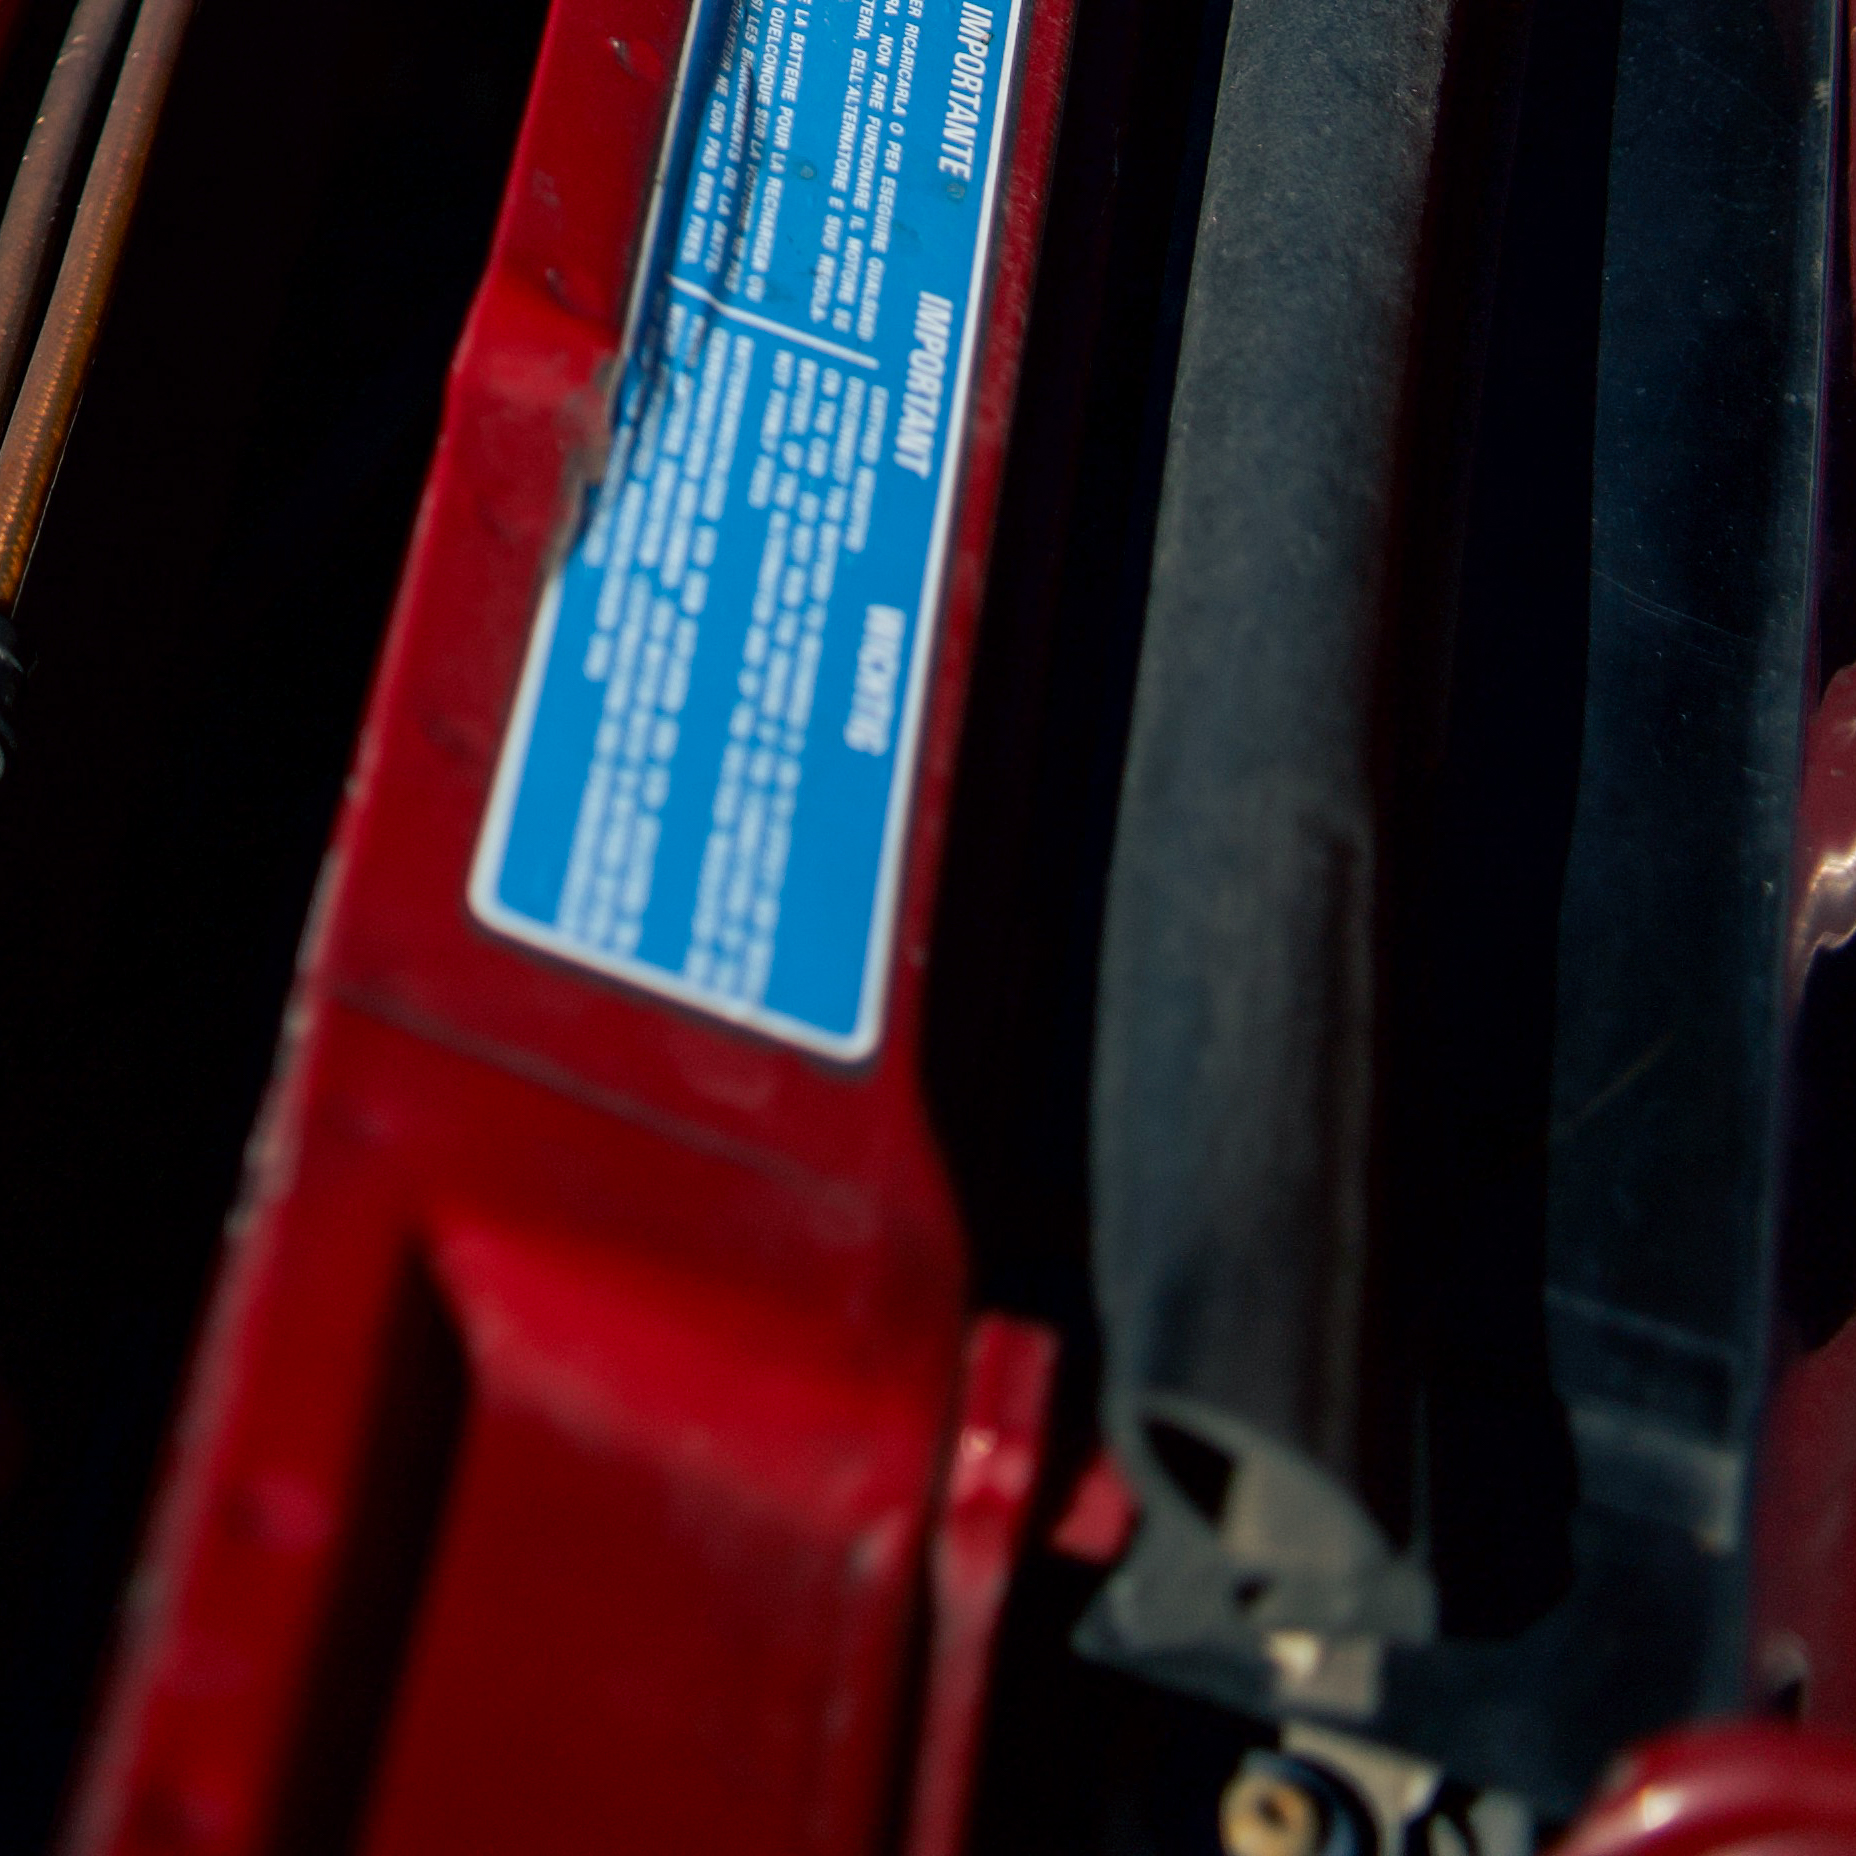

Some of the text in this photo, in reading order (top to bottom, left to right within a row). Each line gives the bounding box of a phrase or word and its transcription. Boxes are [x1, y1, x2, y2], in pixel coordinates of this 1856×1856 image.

[742, 13, 761, 45] LES
[793, 6, 809, 29] LA
[756, 5, 784, 107] QUELCONQUE
[780, 30, 805, 103] BATTERIE
[875, 32, 893, 68] NON
[891, 21, 920, 118] RICARICARLA
[714, 73, 730, 97] NE
[725, 45, 755, 164] BRANCHEMENTS
[868, 70, 887, 111] FARE
[937, 0, 993, 182] IMPORTANTE
[707, 98, 726, 134] SON
[751, 105, 769, 139] SUR
[771, 103, 793, 151] POUR
[829, 46, 865, 192] DELL'ALTERNATORE
[699, 135, 721, 170] PAS
[747, 138, 764, 161] LA
[767, 149, 785, 175] LA
[851, 113, 881, 211] FUNZIONARE
[882, 138, 901, 173] PER
[720, 164, 738, 191] DE
[715, 191, 733, 216] LA
[847, 212, 866, 234] IL
[869, 173, 896, 254] ESEGUIRE
[819, 211, 840, 252] SUO
[835, 234, 863, 307] MOTORE
[854, 254, 883, 343] QUALSIASI
[891, 287, 953, 481] IMPORTANT
